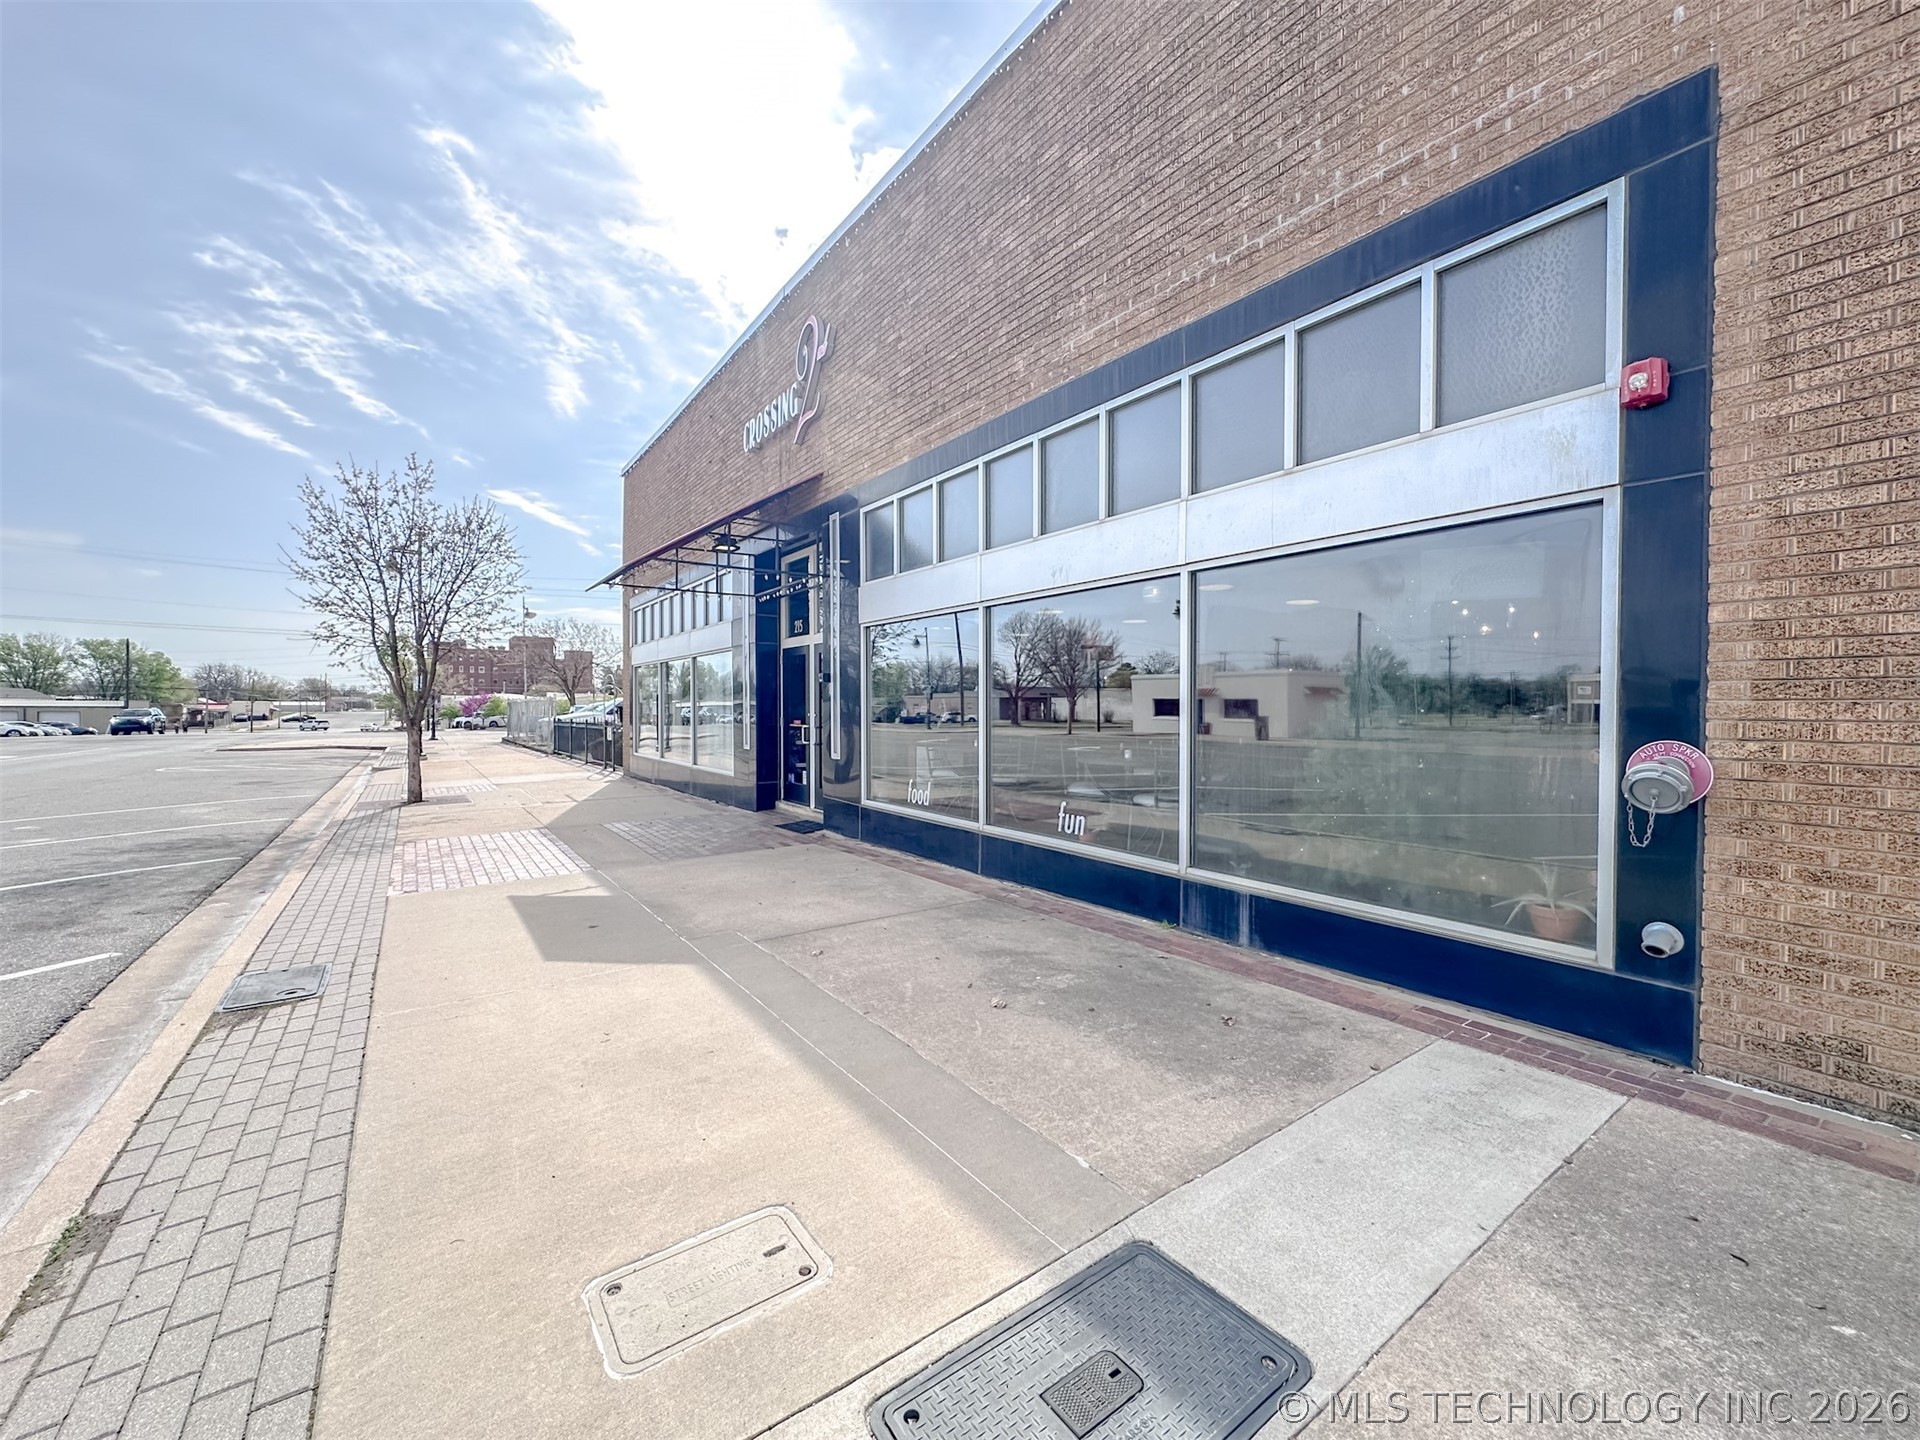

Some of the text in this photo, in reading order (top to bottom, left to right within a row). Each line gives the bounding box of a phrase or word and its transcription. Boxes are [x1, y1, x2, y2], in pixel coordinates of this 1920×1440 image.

[743, 381, 800, 453] CROSSING
[794, 619, 803, 633] 215
[1639, 743, 1700, 760] AUTO SPKR
[907, 779, 931, 806] food
[1057, 801, 1086, 836] fun
[667, 1279, 705, 1303] STREET
